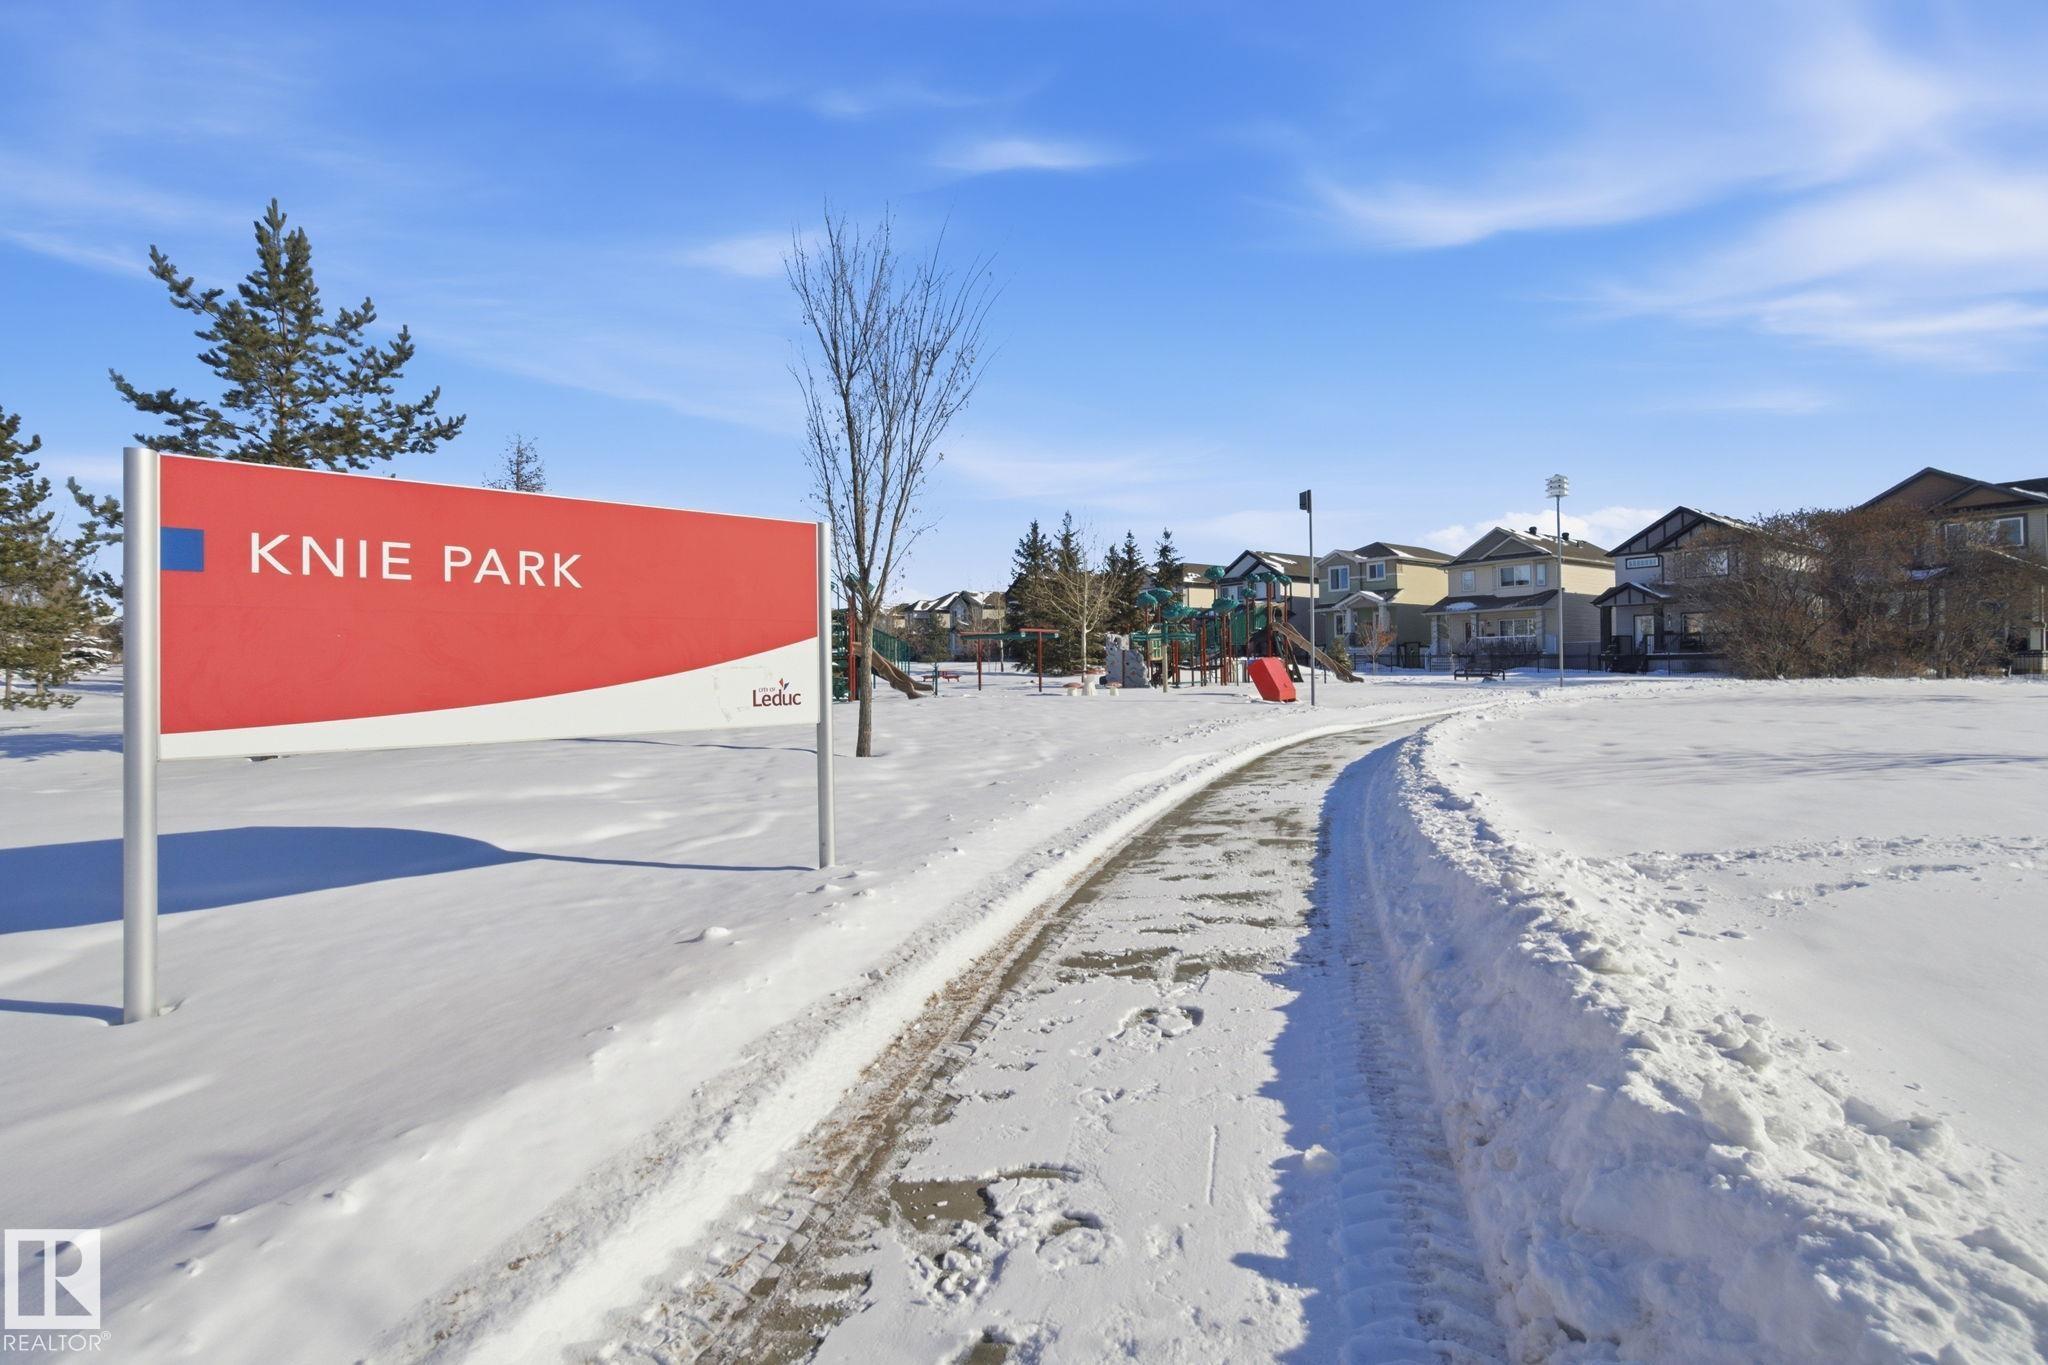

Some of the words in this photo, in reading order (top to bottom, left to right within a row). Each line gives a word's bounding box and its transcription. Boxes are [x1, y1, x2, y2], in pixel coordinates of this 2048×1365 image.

[251, 532, 412, 581] KNIE
[444, 545, 582, 588] PARK
[752, 689, 802, 707] Leduc
